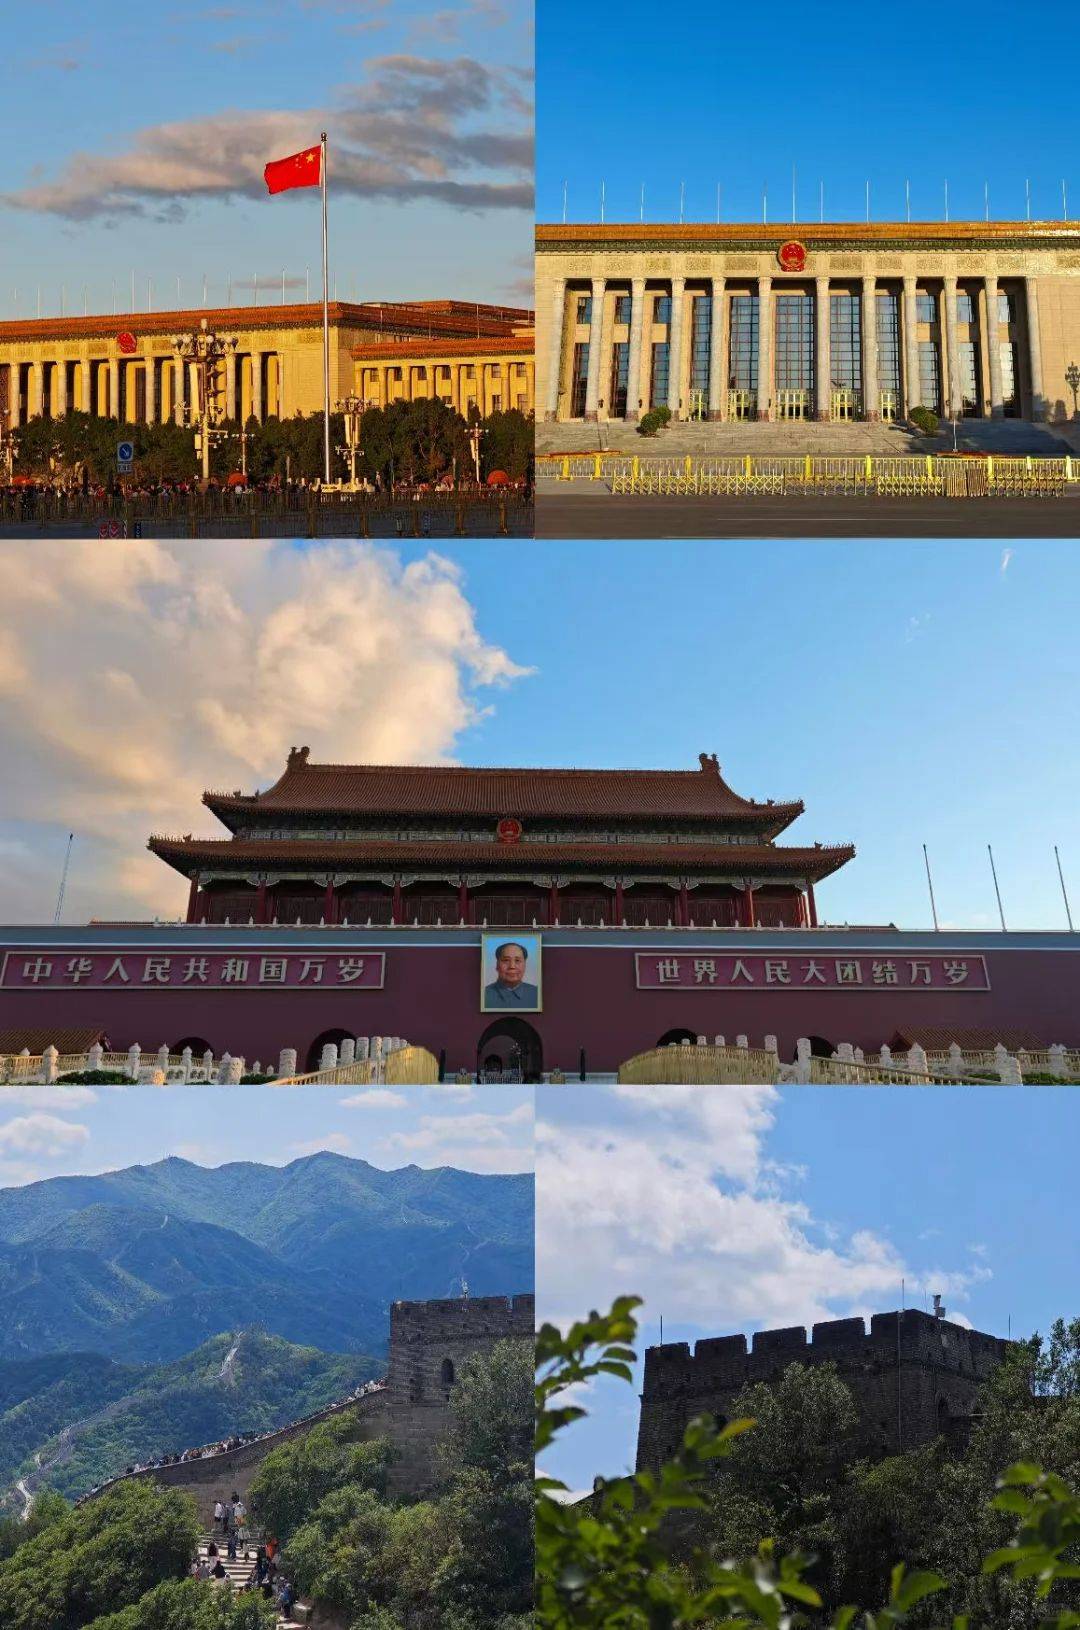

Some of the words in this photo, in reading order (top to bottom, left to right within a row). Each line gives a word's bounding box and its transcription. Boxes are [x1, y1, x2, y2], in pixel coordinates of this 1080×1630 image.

[22, 957, 365, 983] 中华人民共和国万岁
[655, 959, 971, 985] 世界人民大团结万岁
